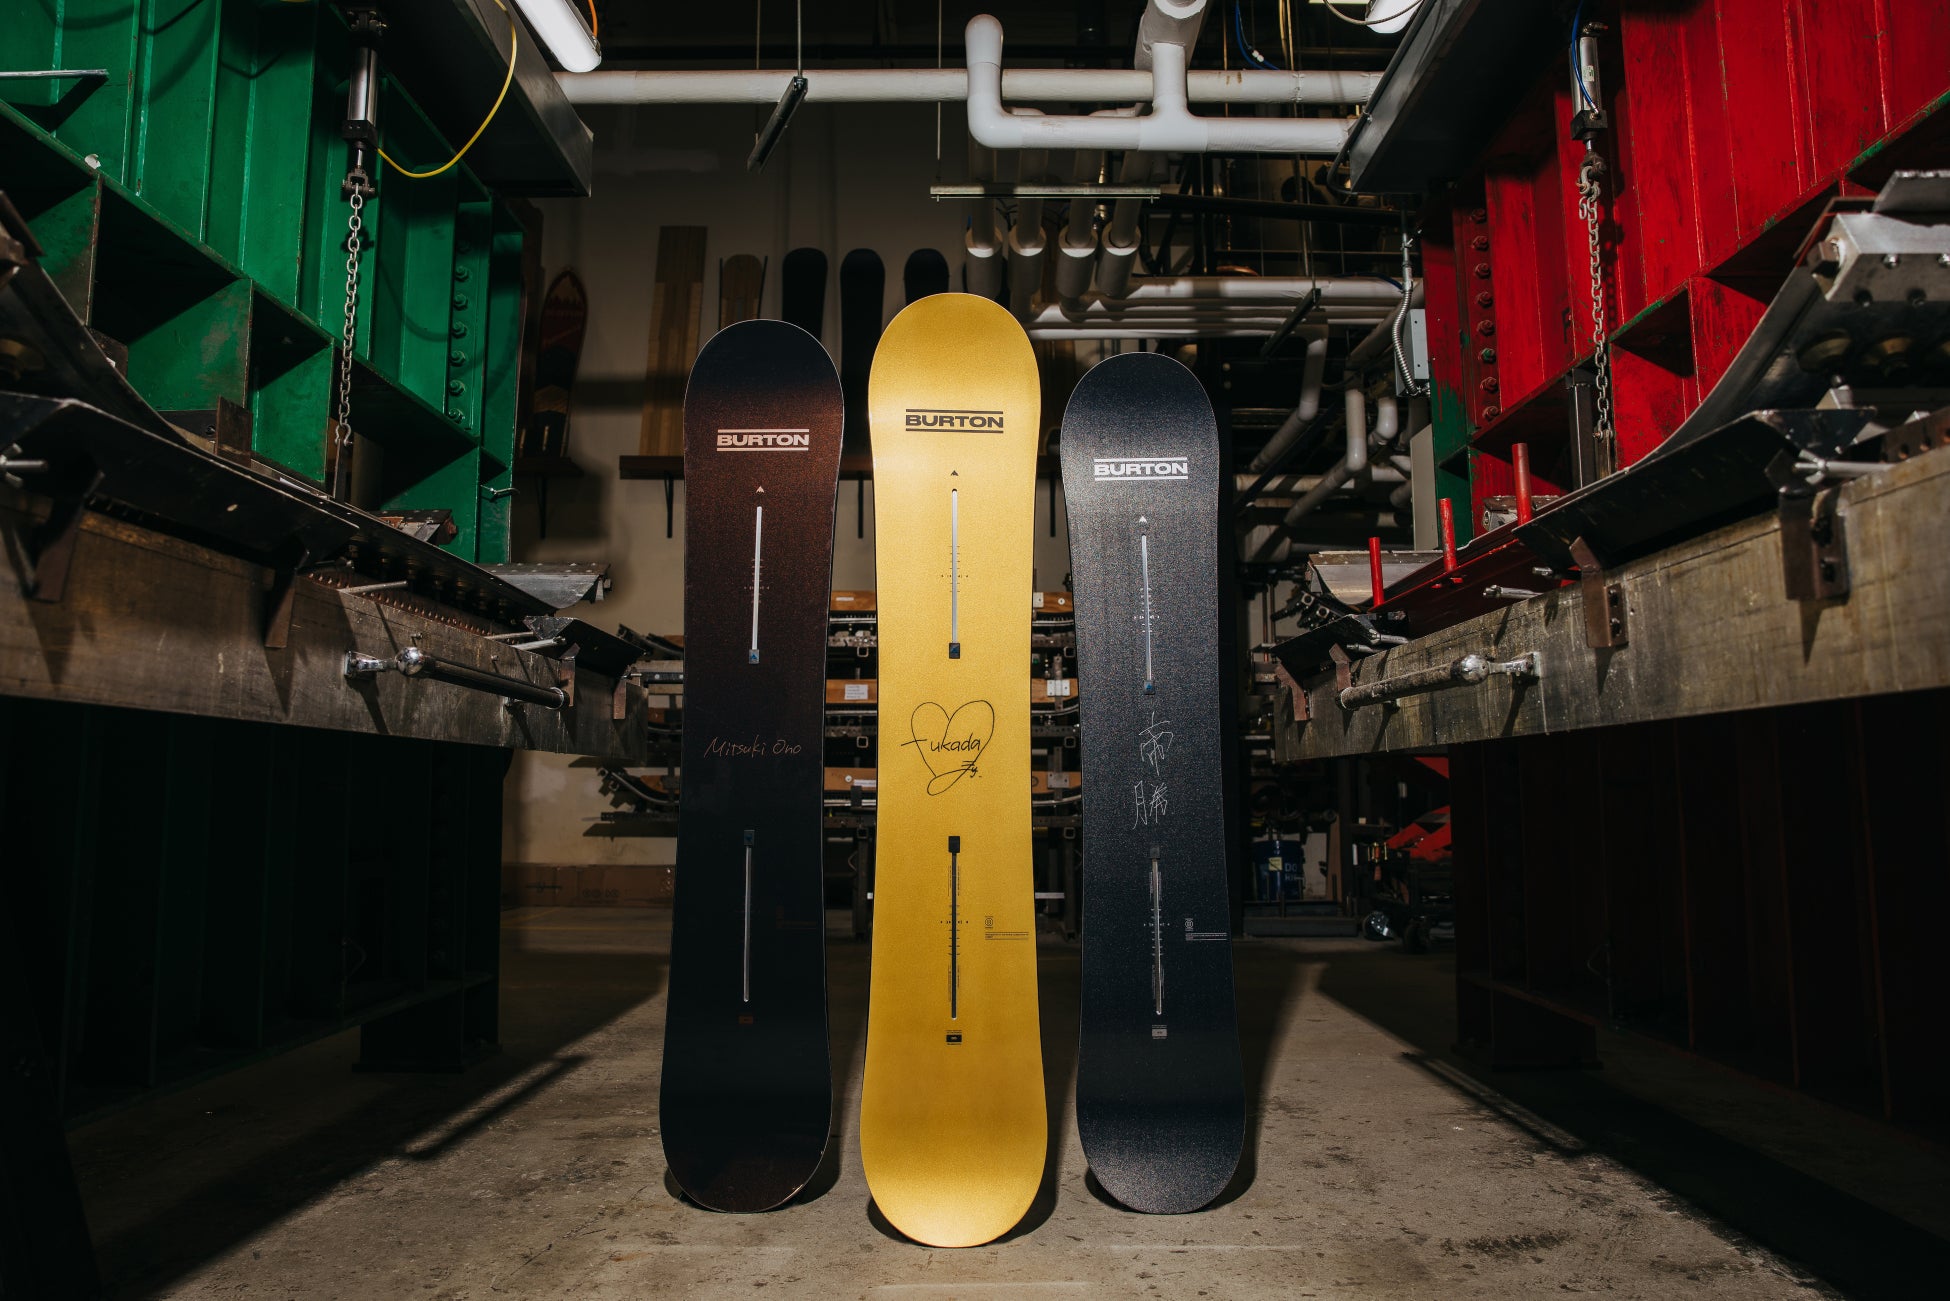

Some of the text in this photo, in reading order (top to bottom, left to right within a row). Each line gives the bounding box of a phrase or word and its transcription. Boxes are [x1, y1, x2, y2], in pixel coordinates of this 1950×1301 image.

[906, 414, 1004, 428] BURTON
[716, 434, 810, 446] BURTON
[1094, 462, 1188, 476] BURTON
[703, 734, 767, 759] Mitsuki
